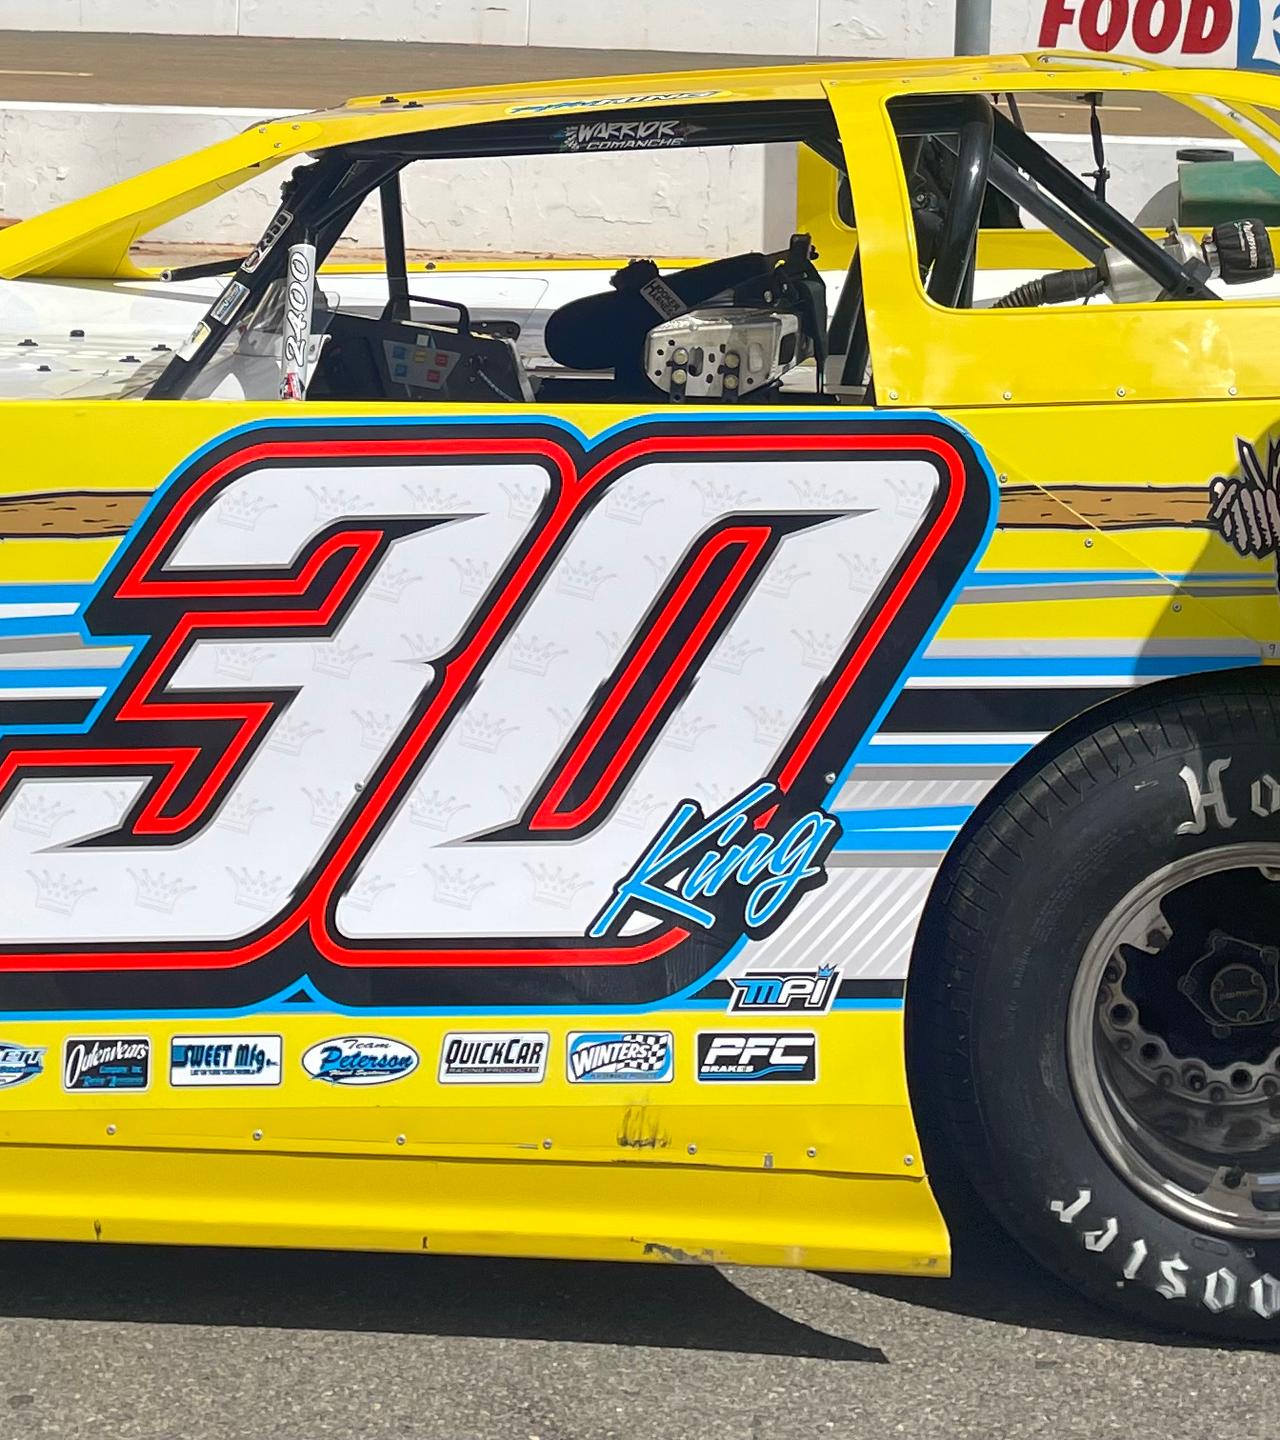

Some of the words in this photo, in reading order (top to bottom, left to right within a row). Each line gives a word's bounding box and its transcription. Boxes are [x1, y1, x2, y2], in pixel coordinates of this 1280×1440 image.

[578, 120, 680, 141] WARRIOR
[284, 251, 310, 368] 2400
[588, 782, 837, 938] King
[180, 1043, 233, 1068] SWEET
[320, 1044, 413, 1071] Peterson
[342, 1038, 391, 1050] Team
[446, 1038, 545, 1068] QUICKCAR
[703, 1037, 815, 1065] PFC
[571, 1040, 651, 1080] WINTERS
[700, 1064, 754, 1073] BRAKES
